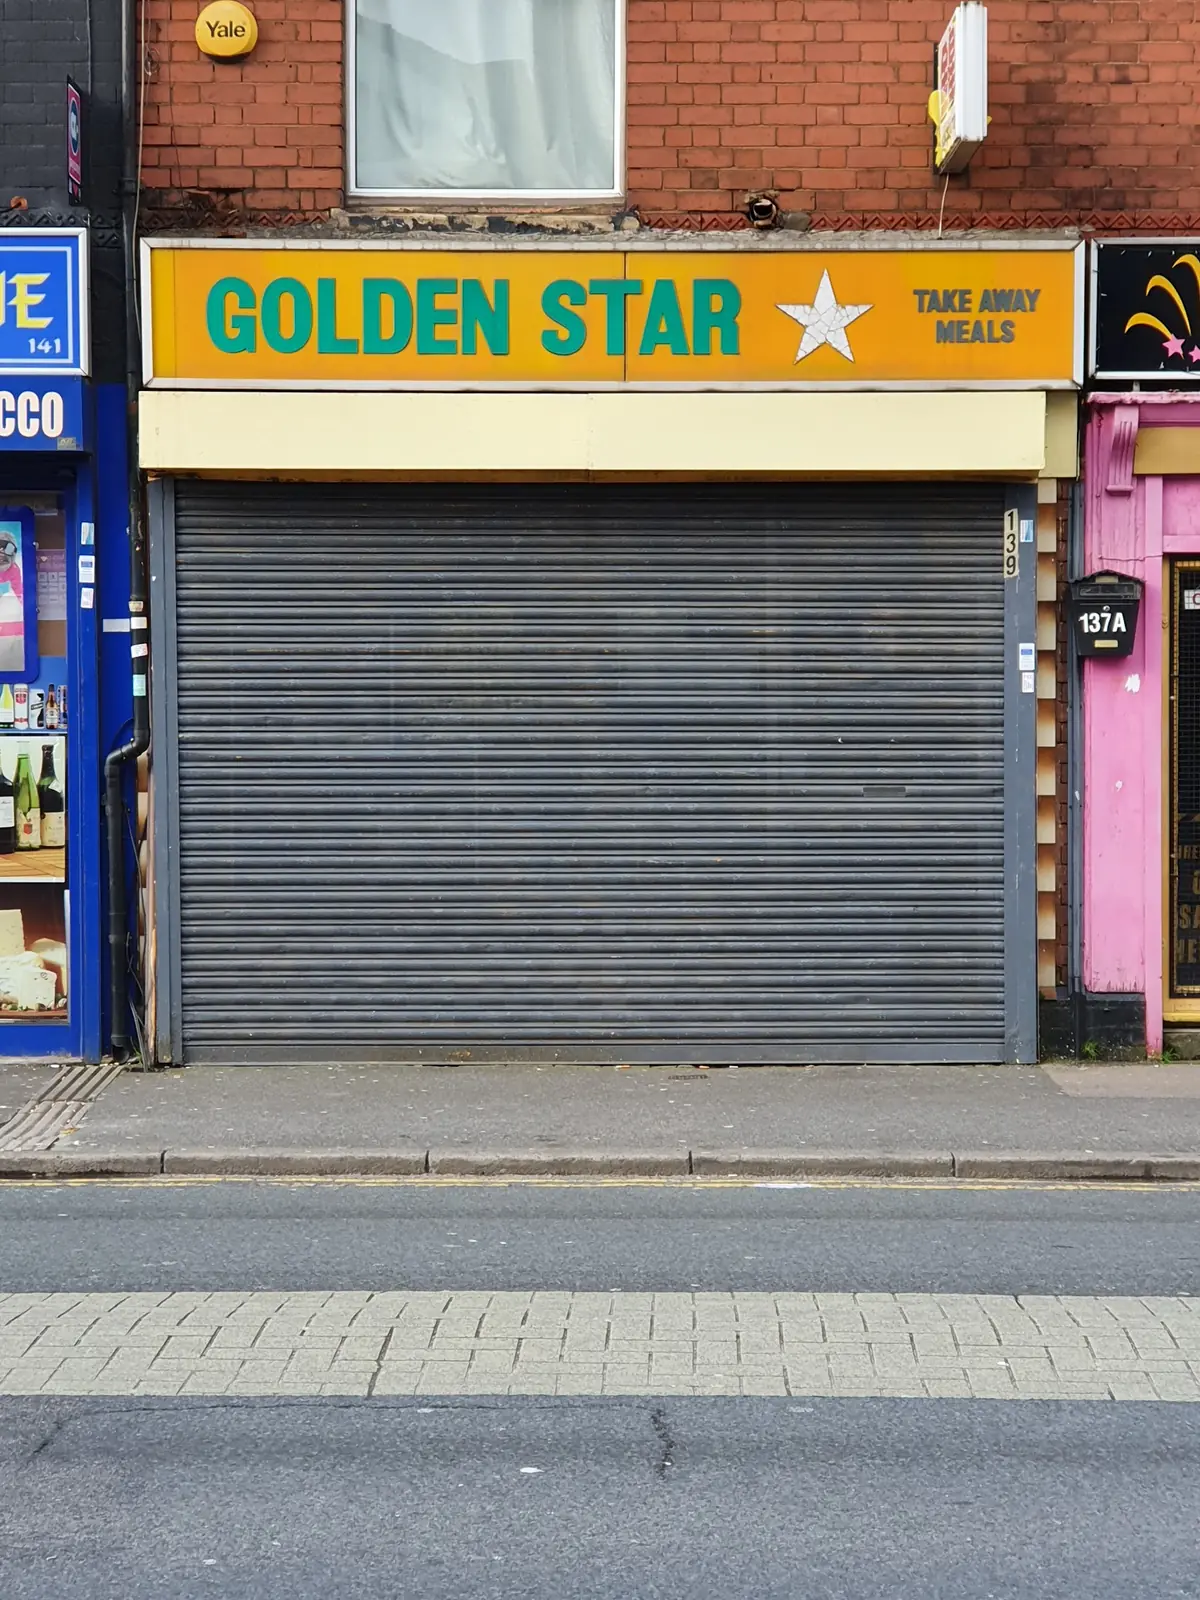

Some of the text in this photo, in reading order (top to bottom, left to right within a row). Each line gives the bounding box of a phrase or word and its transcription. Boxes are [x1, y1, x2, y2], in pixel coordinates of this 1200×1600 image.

[205, 20, 246, 38] Yale
[0, 271, 54, 329] E
[914, 289, 1041, 313] TAKE AWAY
[206, 277, 741, 356] GOLDEN STAR
[936, 320, 1016, 344] MEALS
[28, 337, 61, 354] 141
[1006, 510, 1017, 576] 139
[1078, 612, 1127, 633] 137A
